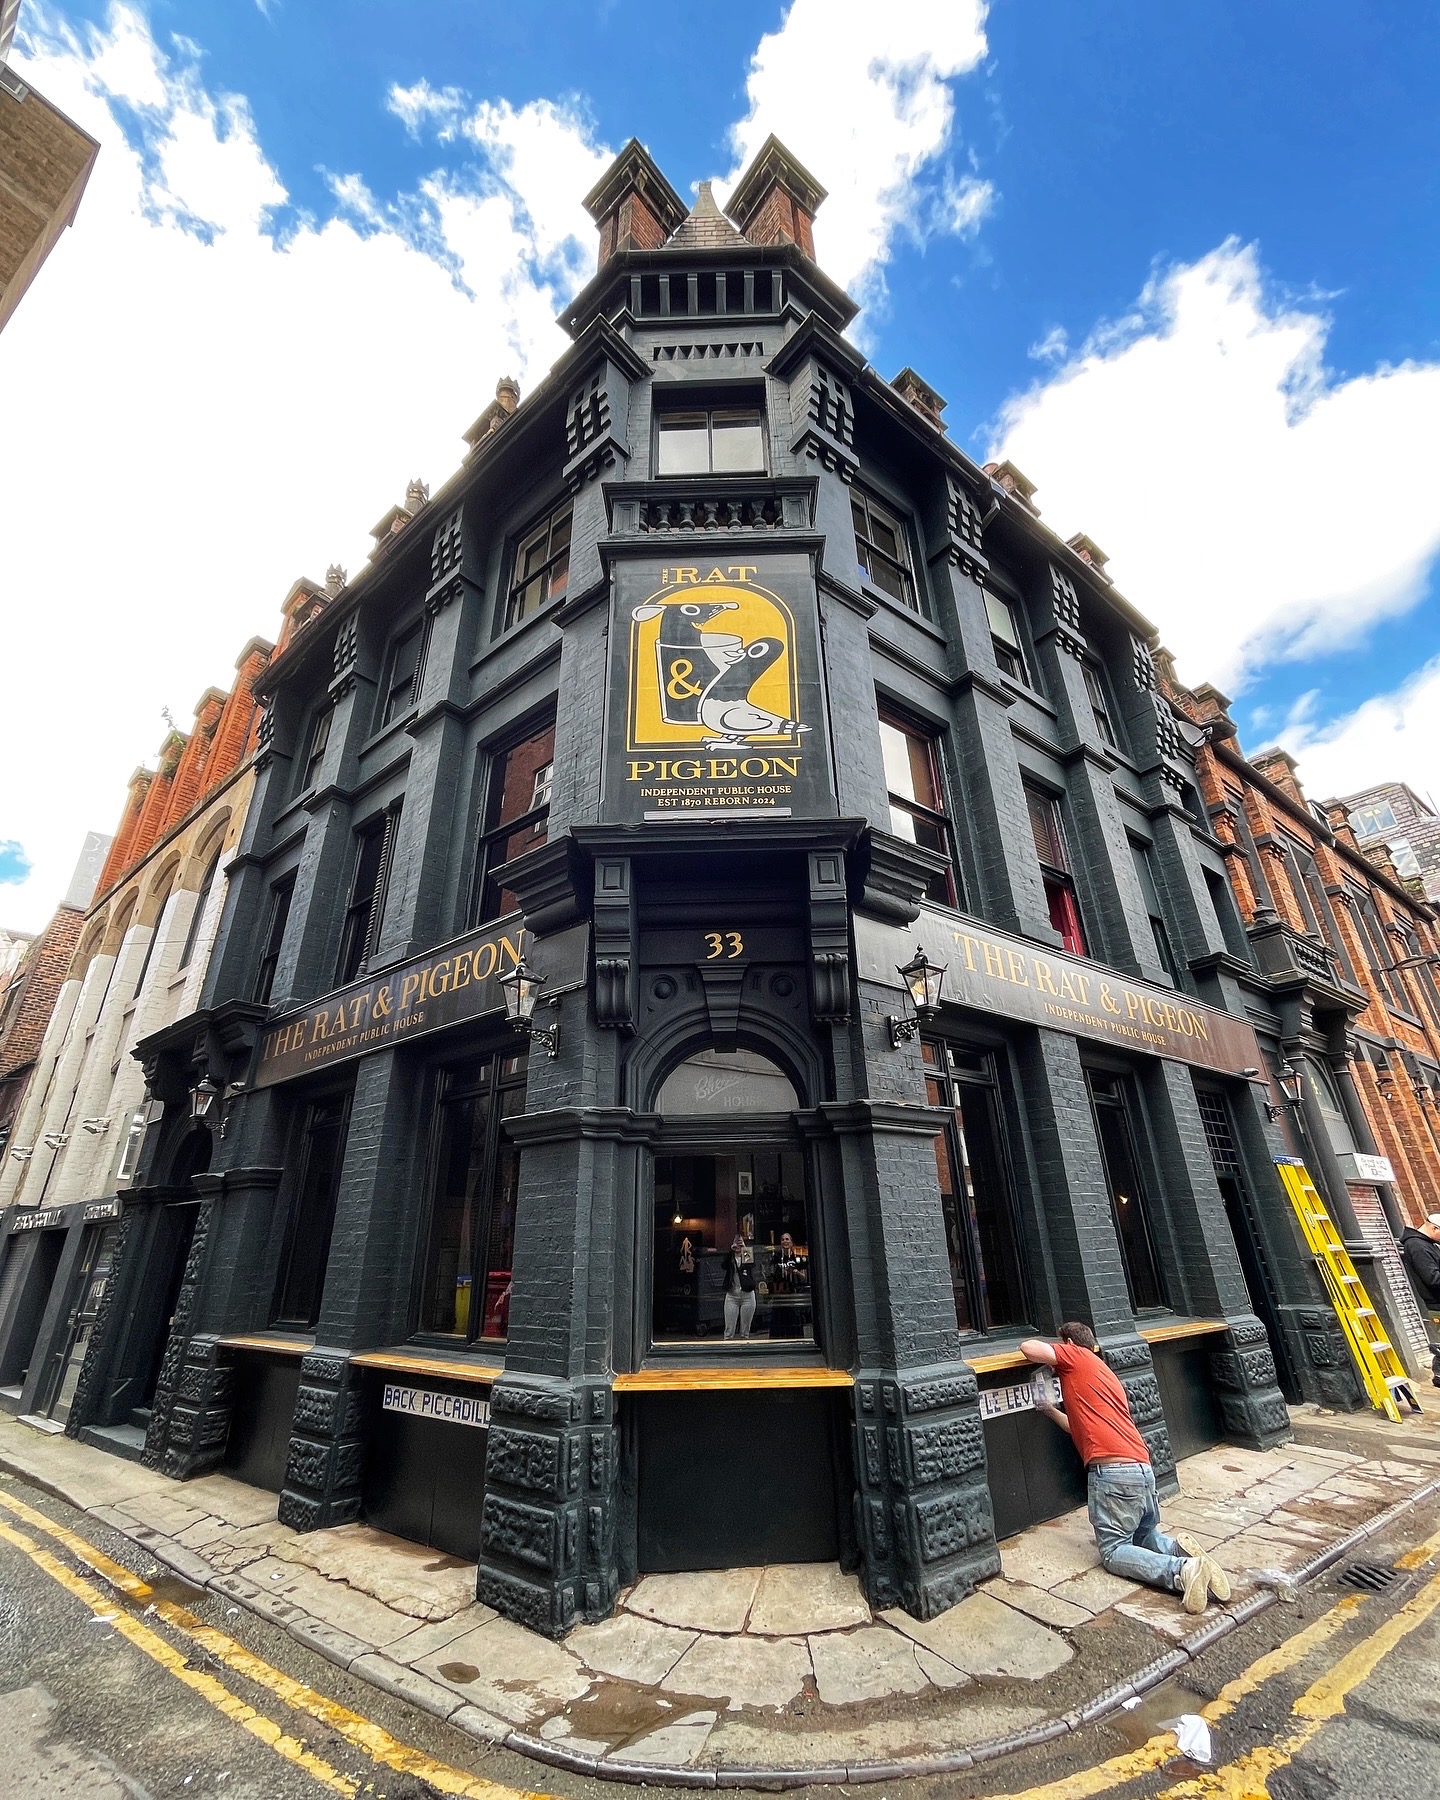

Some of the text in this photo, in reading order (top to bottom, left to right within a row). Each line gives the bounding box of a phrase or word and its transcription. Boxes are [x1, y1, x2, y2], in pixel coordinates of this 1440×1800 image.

[670, 566, 757, 584] RAT
[667, 658, 703, 699] &
[625, 756, 802, 781] PIGEON
[641, 785, 792, 796] INDEPENDENT PUBLIC HOUSE
[657, 796, 776, 807] EST 1870 REBORN 2024
[704, 932, 744, 959] 33
[262, 928, 527, 1062] THE RAT & PIGEON
[953, 931, 1209, 1042] THE RAT & PIGEON
[304, 1011, 424, 1062] INDEPENDENT PUBLIC HOUSE
[1044, 1002, 1166, 1046] INDEPENDENT PUBLIC HOUSE
[384, 1387, 490, 1425] BACK PICCADILL
[1006, 1384, 1046, 1409] LEV
